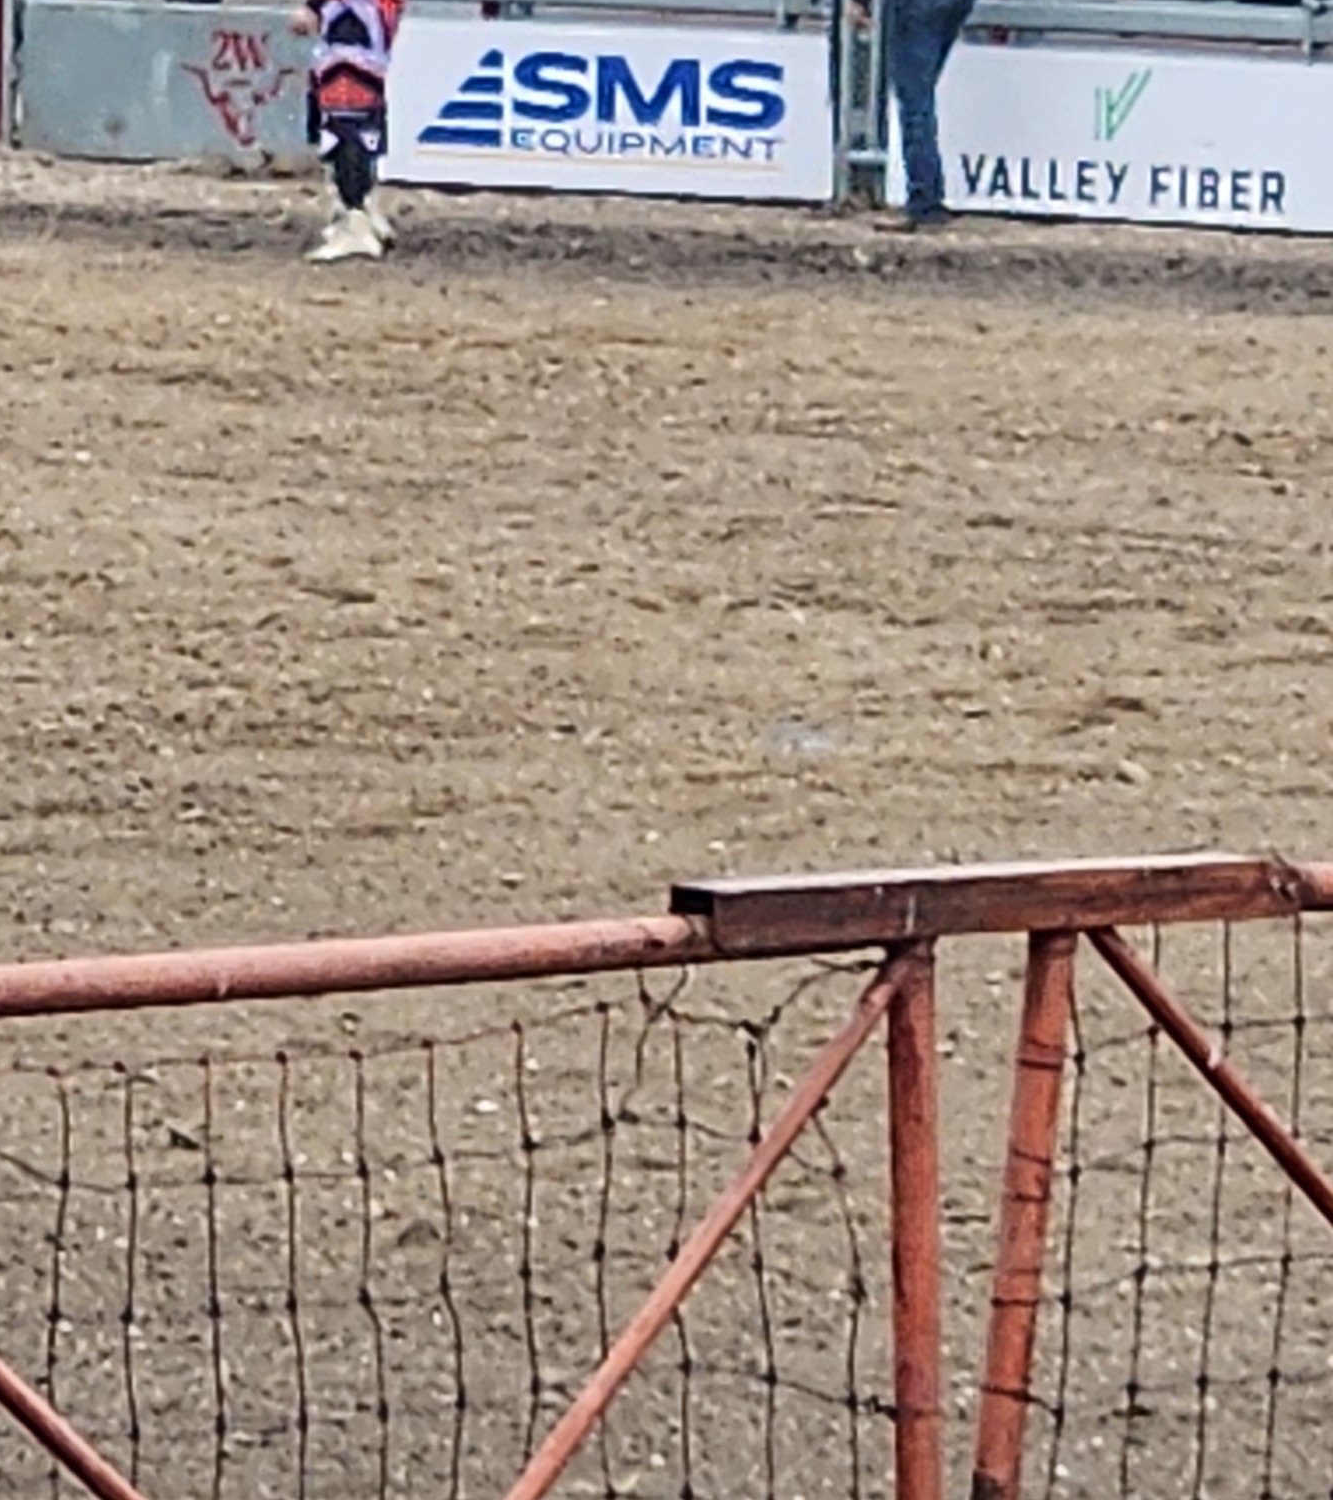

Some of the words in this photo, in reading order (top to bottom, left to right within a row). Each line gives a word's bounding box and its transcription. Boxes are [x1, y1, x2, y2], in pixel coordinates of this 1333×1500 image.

[512, 51, 786, 130] SMS
[511, 128, 783, 161] EQUIPMENT
[960, 153, 1129, 204] VALLEY
[1148, 164, 1286, 214] FIBER
